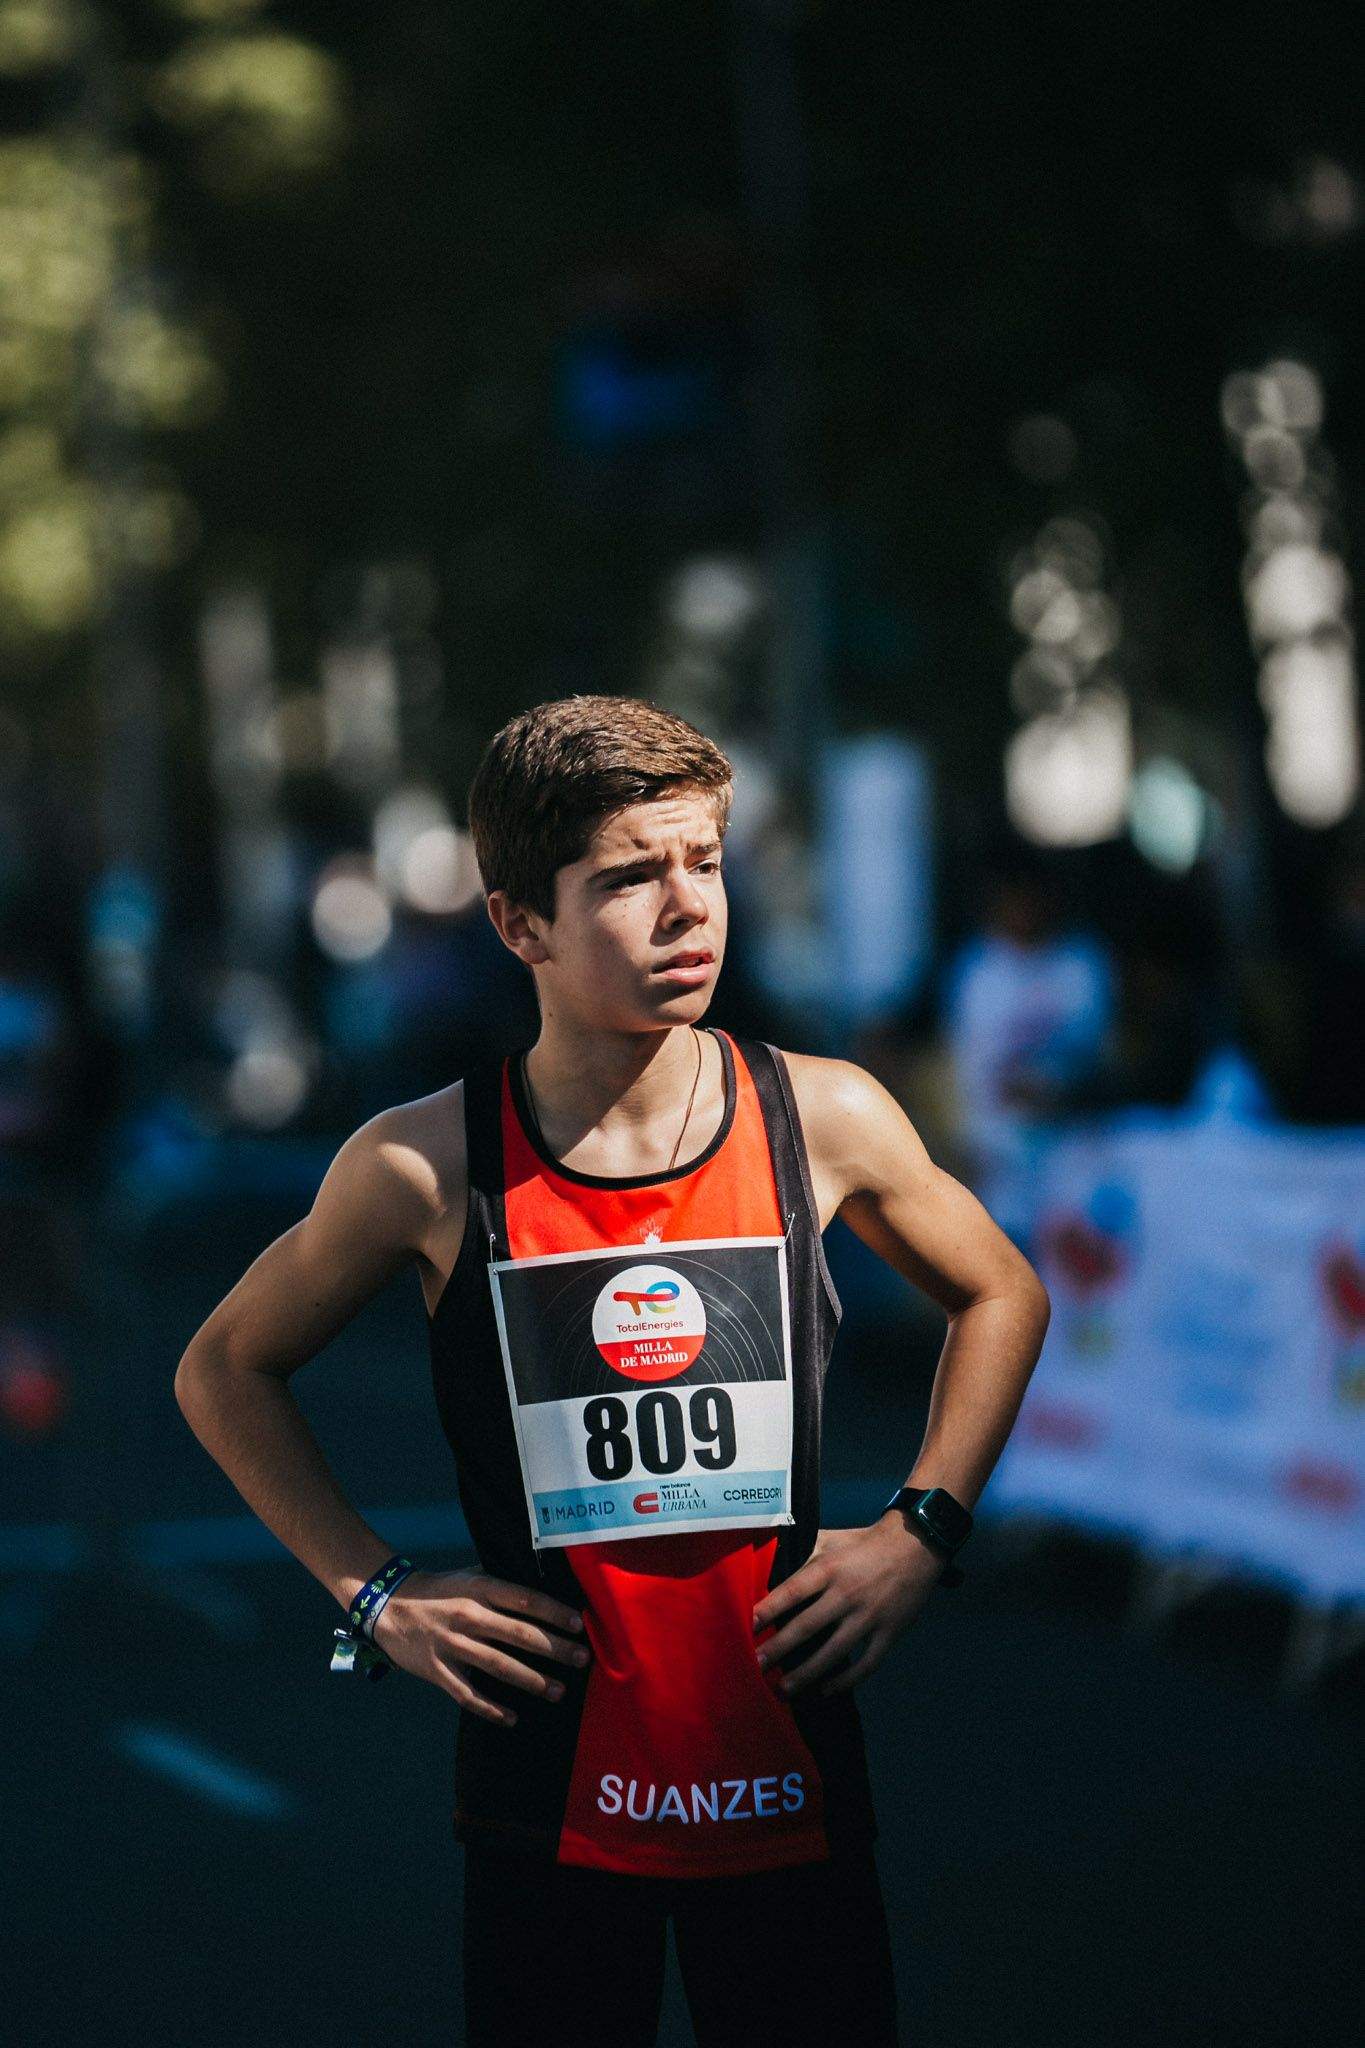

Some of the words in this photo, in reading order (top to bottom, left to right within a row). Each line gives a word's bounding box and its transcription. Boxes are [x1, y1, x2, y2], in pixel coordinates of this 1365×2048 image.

[616, 1320, 684, 1333] TotalEnergies
[634, 1341, 673, 1354] MILLA
[620, 1356, 638, 1368] DE
[640, 1352, 688, 1366] MADRID
[583, 1387, 737, 1481] 809
[661, 1488, 701, 1500] MILLA
[555, 1501, 615, 1520] MADRID
[662, 1499, 707, 1512] URBANA
[598, 1772, 805, 1825] SUANZES
